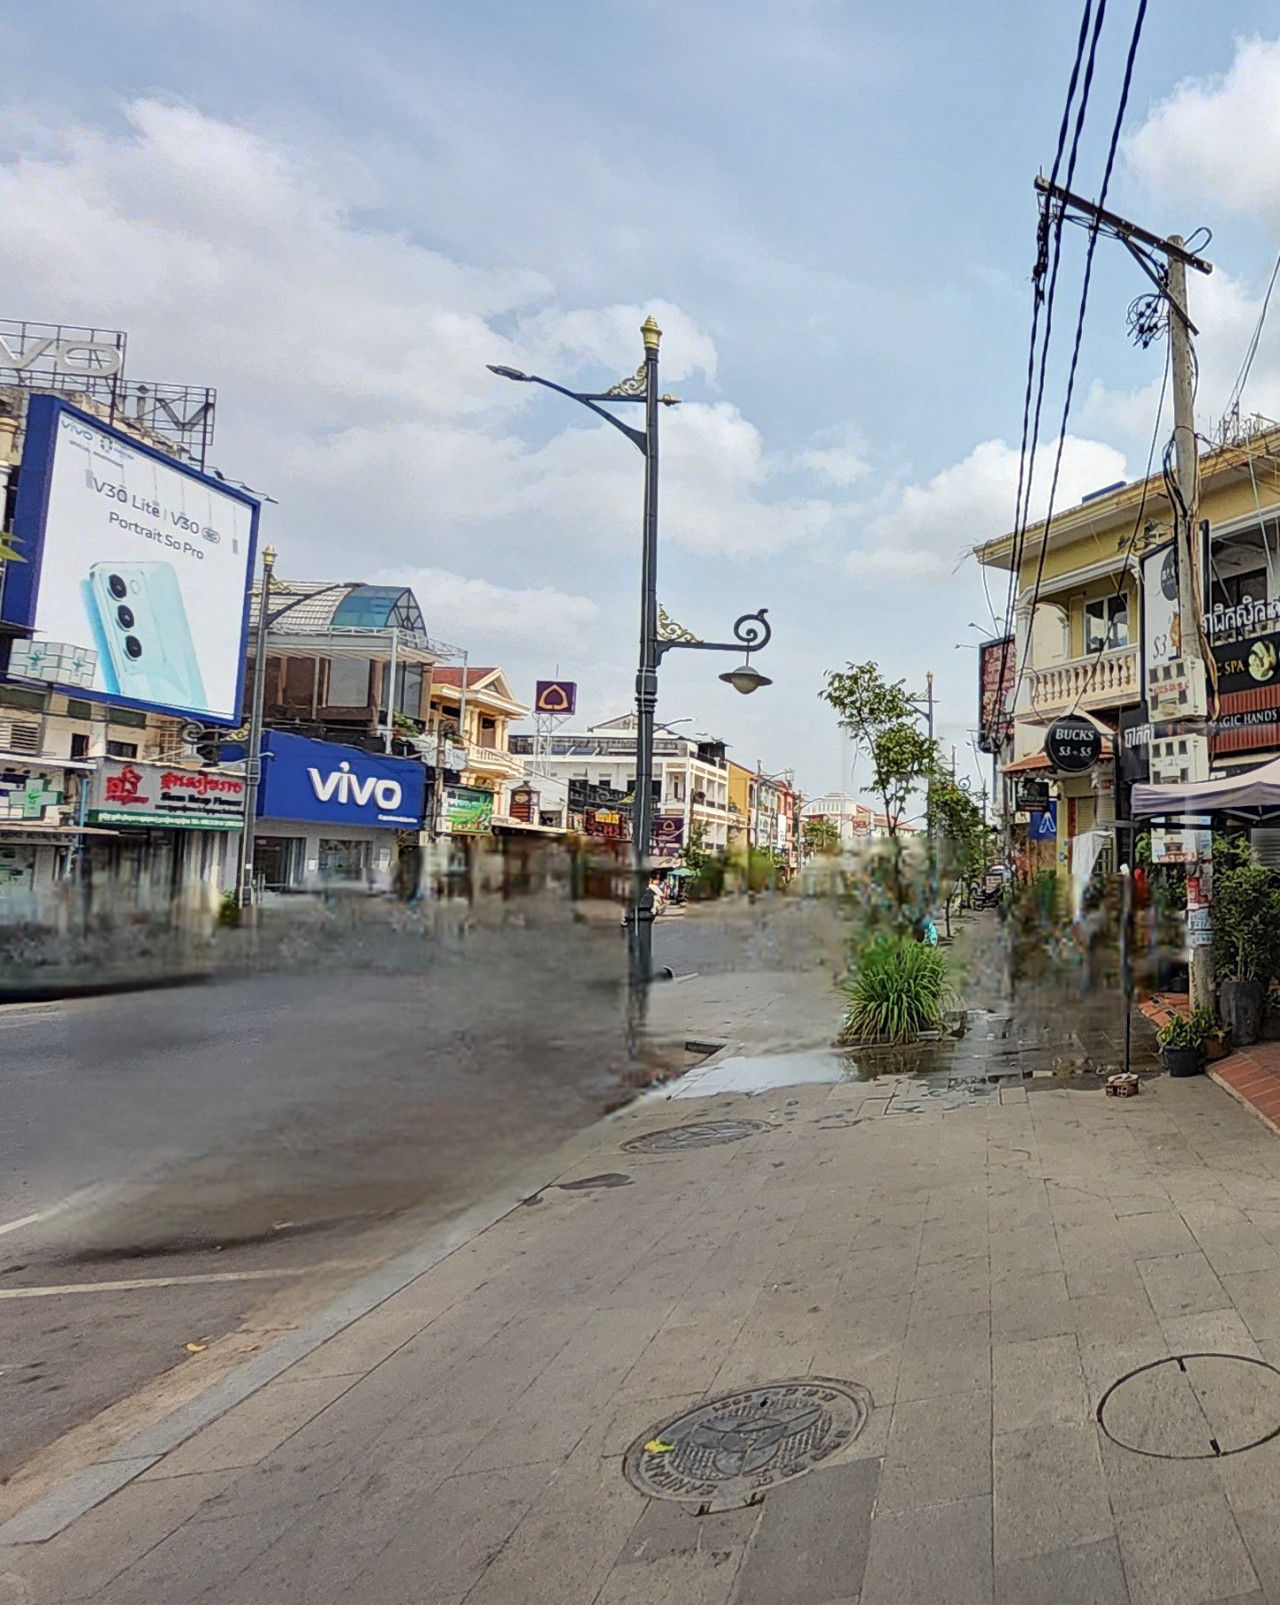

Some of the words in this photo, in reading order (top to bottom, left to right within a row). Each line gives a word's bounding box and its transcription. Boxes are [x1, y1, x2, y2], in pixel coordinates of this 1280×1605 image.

[92, 477, 128, 504] V30
[131, 494, 161, 519] Lite
[170, 511, 200, 535] V30
[108, 511, 164, 545] Portrait
[164, 533, 182, 551] So
[182, 541, 205, 560] Pro
[1224, 658, 1246, 676] SPA
[1243, 708, 1278, 725] HANDS
[1055, 728, 1096, 742] BUCKS
[306, 761, 403, 811] vivo
